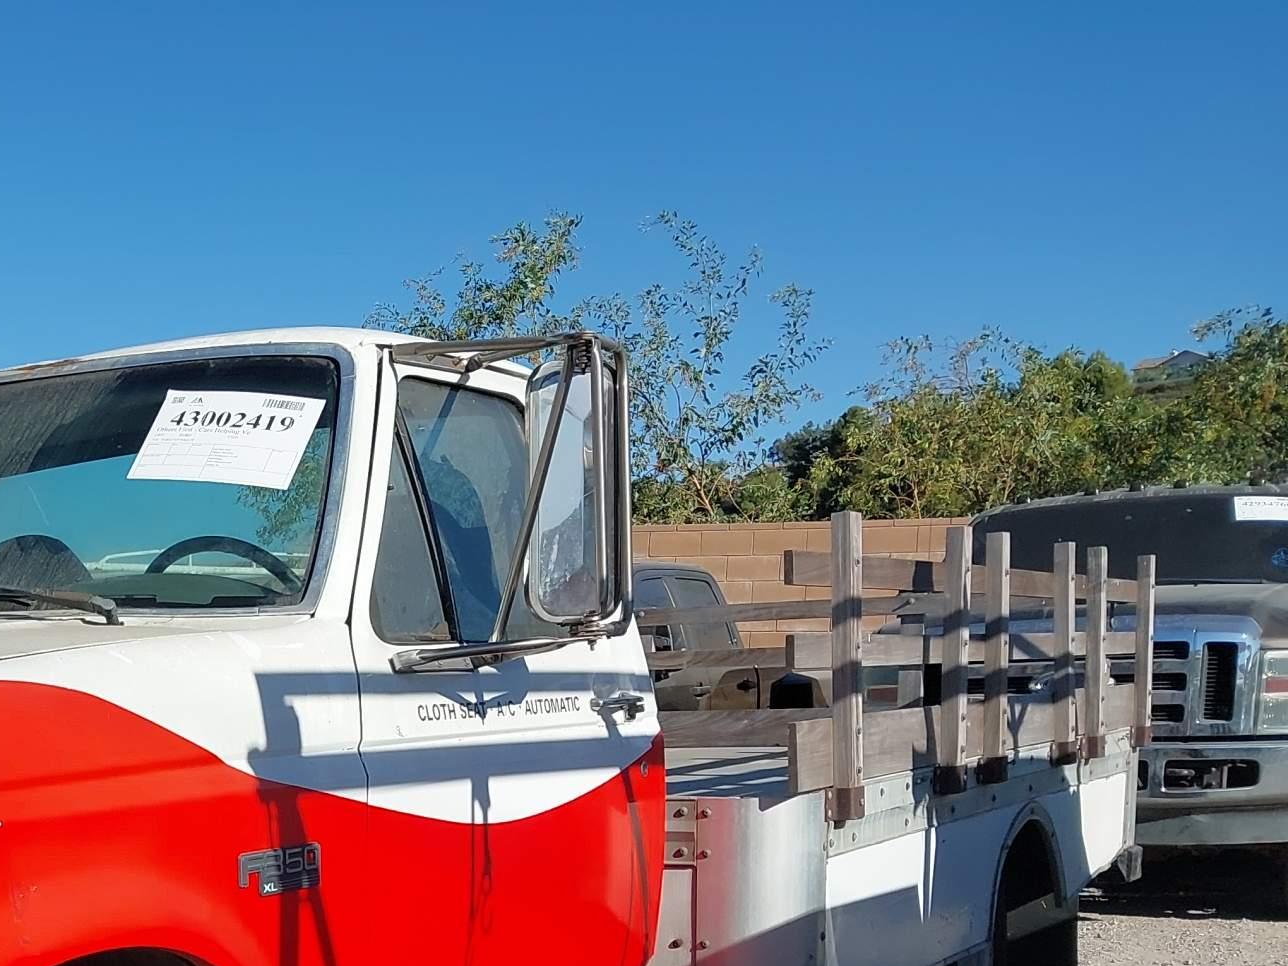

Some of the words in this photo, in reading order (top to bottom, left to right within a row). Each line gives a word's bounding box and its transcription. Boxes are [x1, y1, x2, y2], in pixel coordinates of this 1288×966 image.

[170, 410, 295, 432] 43002419
[417, 703, 457, 721] CLOTH
[461, 701, 487, 719] SEAT
[525, 696, 581, 715] AUTOMATIC
[263, 882, 279, 894] XL
